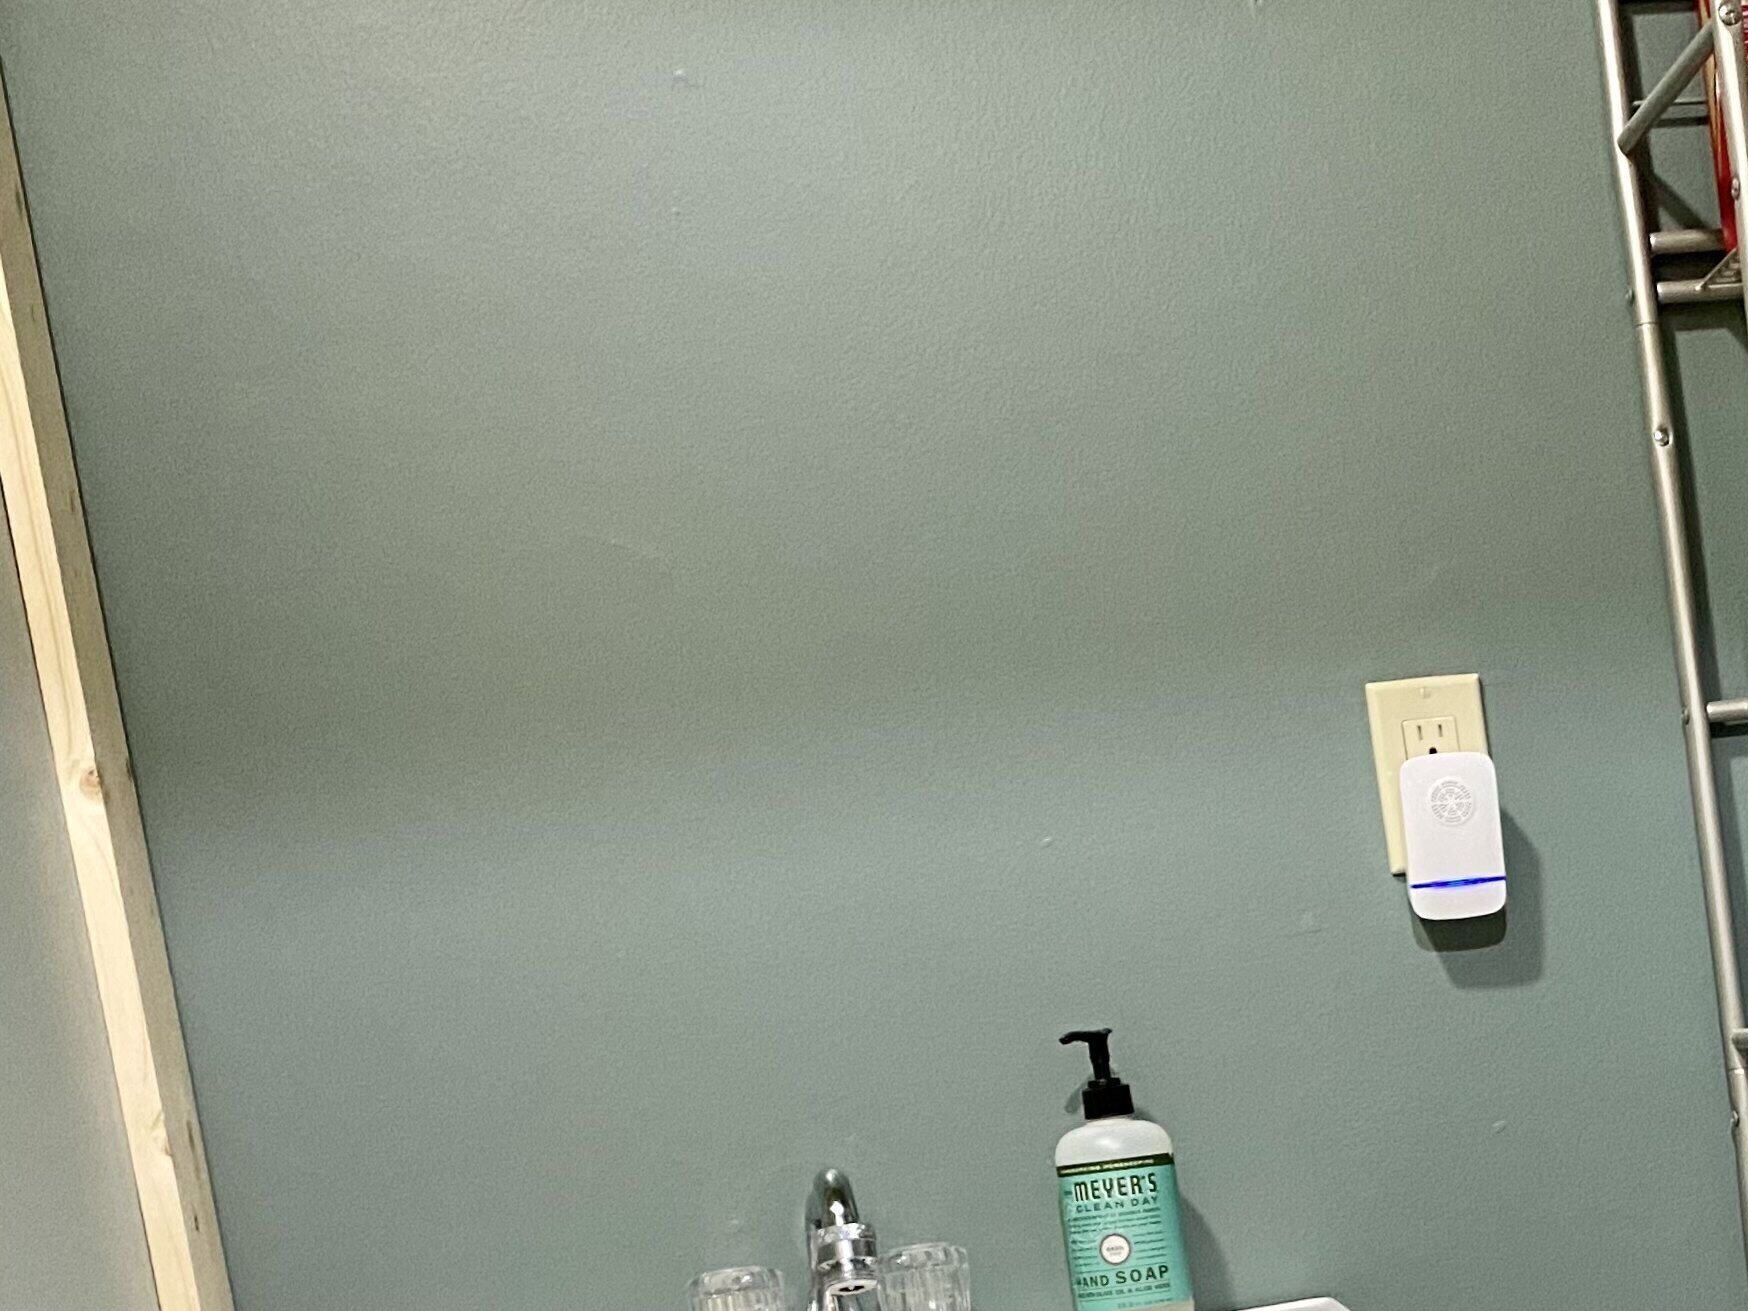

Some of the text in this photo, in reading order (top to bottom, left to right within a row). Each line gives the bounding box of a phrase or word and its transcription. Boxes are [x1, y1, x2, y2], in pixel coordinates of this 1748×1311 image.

[1073, 1172, 1158, 1202] MEYER'S
[1076, 1196, 1159, 1213] CLEAN DAY
[1115, 1264, 1169, 1285] SOAP
